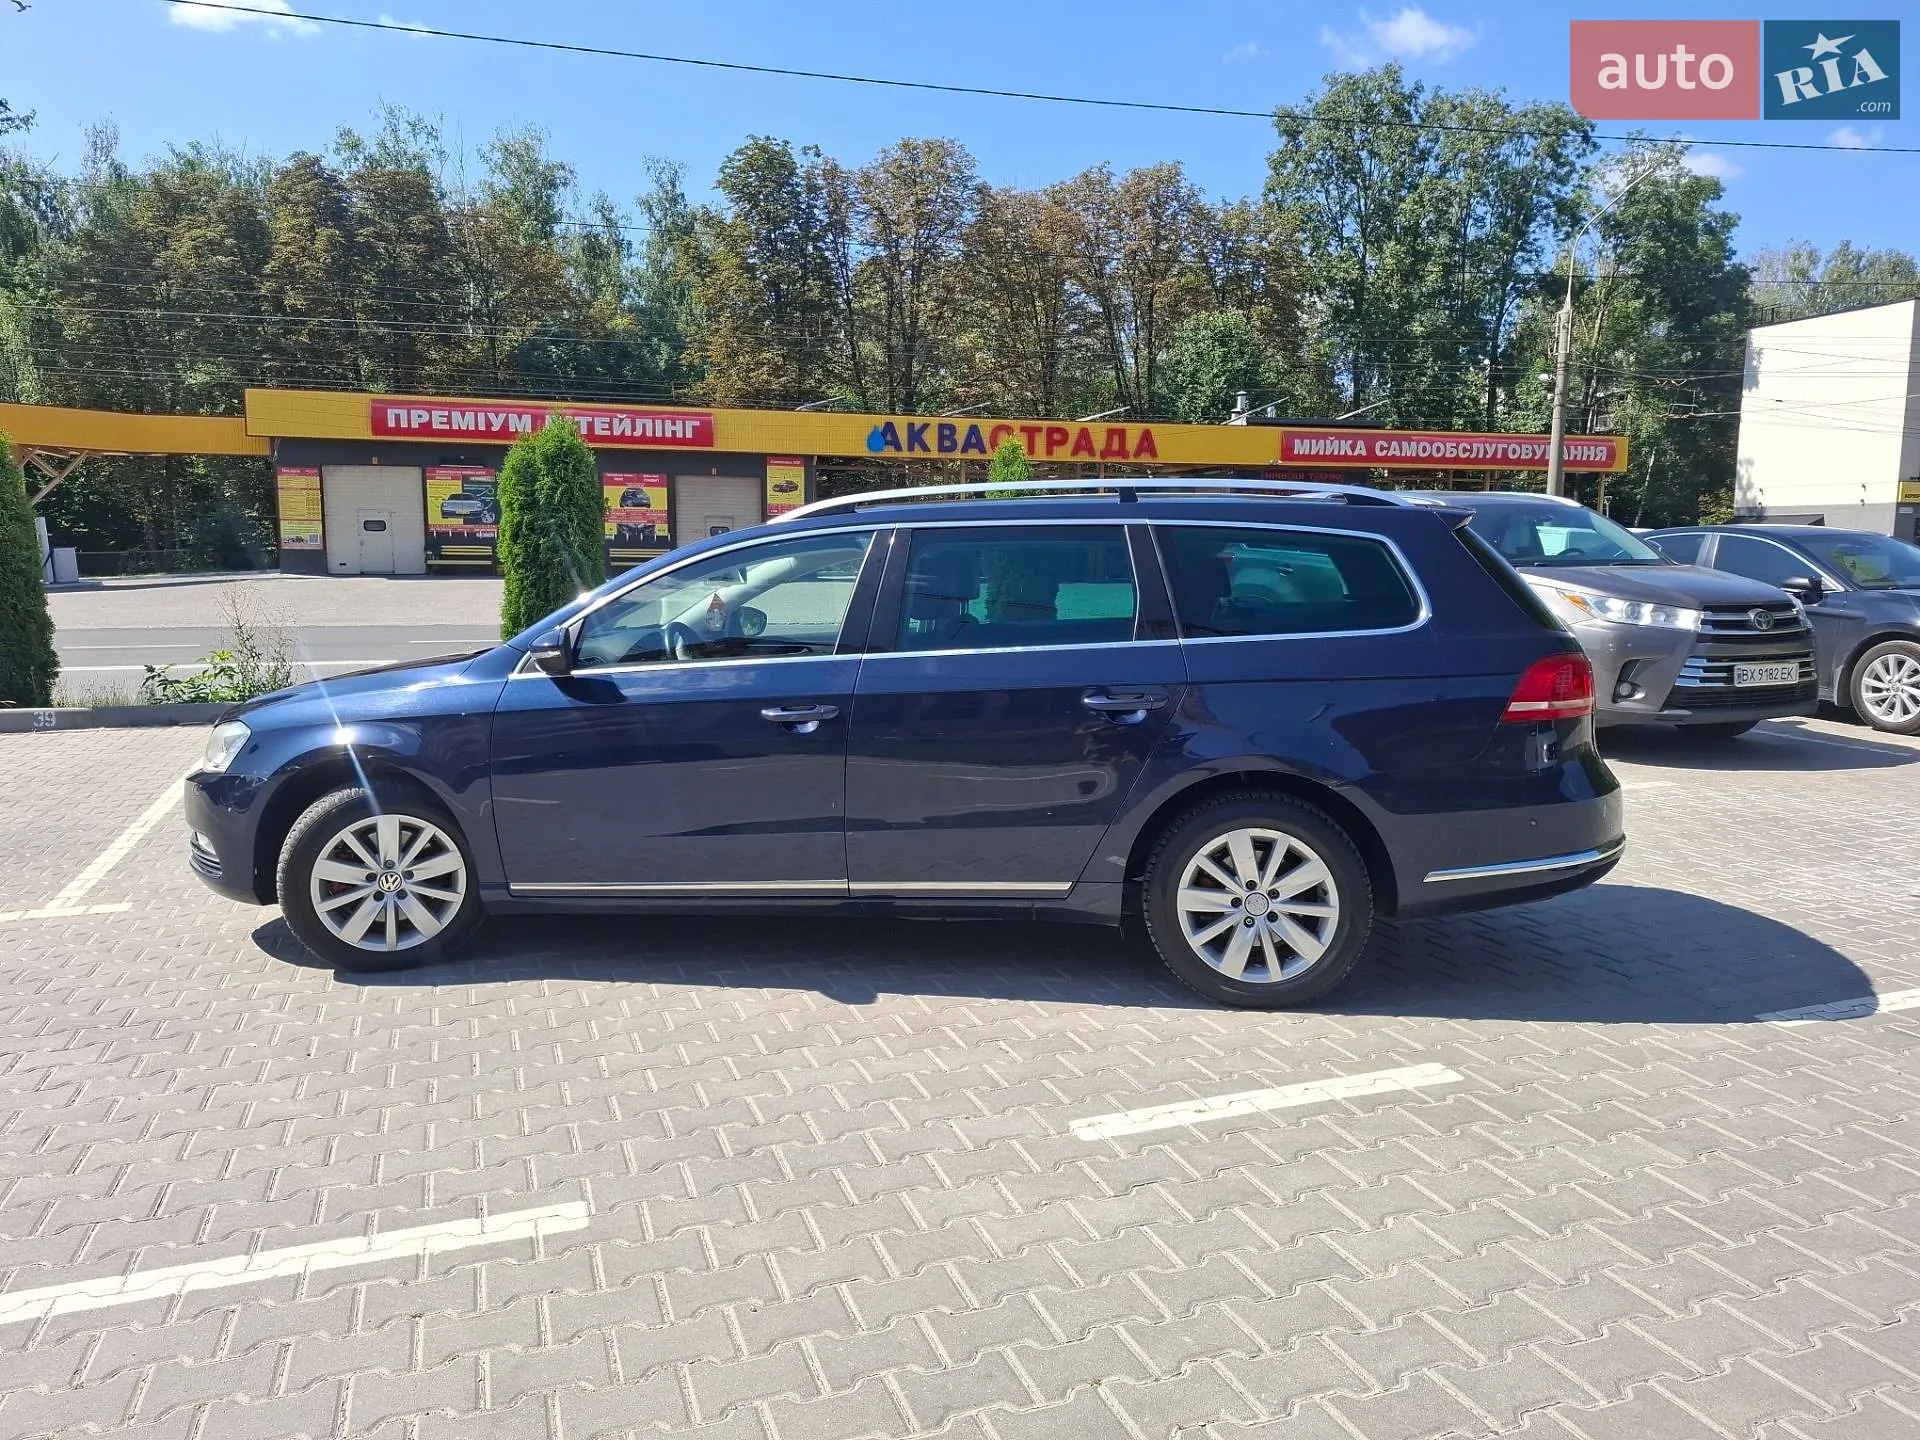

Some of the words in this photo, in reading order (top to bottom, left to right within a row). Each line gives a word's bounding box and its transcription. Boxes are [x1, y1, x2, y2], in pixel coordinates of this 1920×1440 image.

[386, 407, 533, 433] ПРЕМІУМ
[541, 413, 700, 439] ТЕЙЛІНГ
[879, 421, 1159, 460] АКВАСТРАДА
[1293, 436, 1367, 457] МИЙКА
[1758, 667, 1780, 681] 9182
[33, 711, 56, 727] 39
